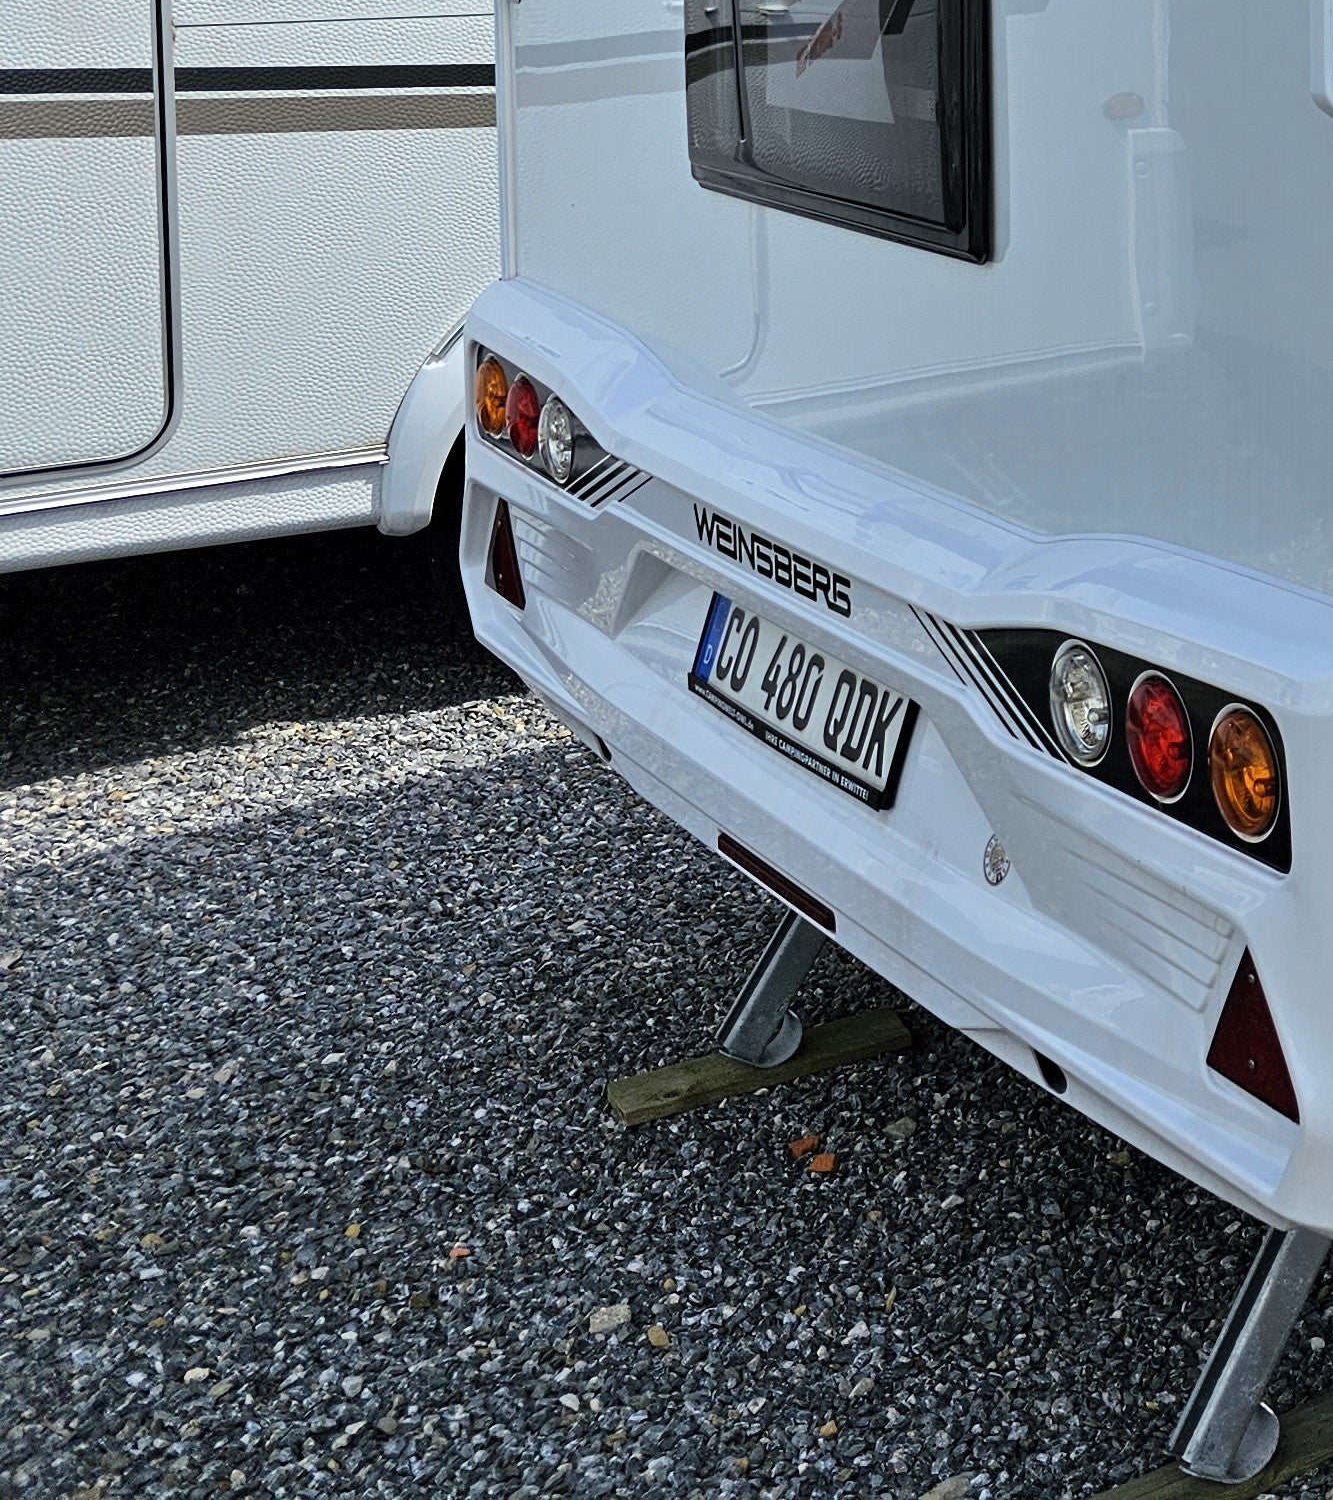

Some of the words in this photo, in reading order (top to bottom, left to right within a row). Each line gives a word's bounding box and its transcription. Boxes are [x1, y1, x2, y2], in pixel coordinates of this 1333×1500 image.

[693, 502, 852, 618] WEINSBERG
[715, 606, 760, 692] CO
[760, 635, 825, 731] 480
[823, 669, 903, 778] QDK
